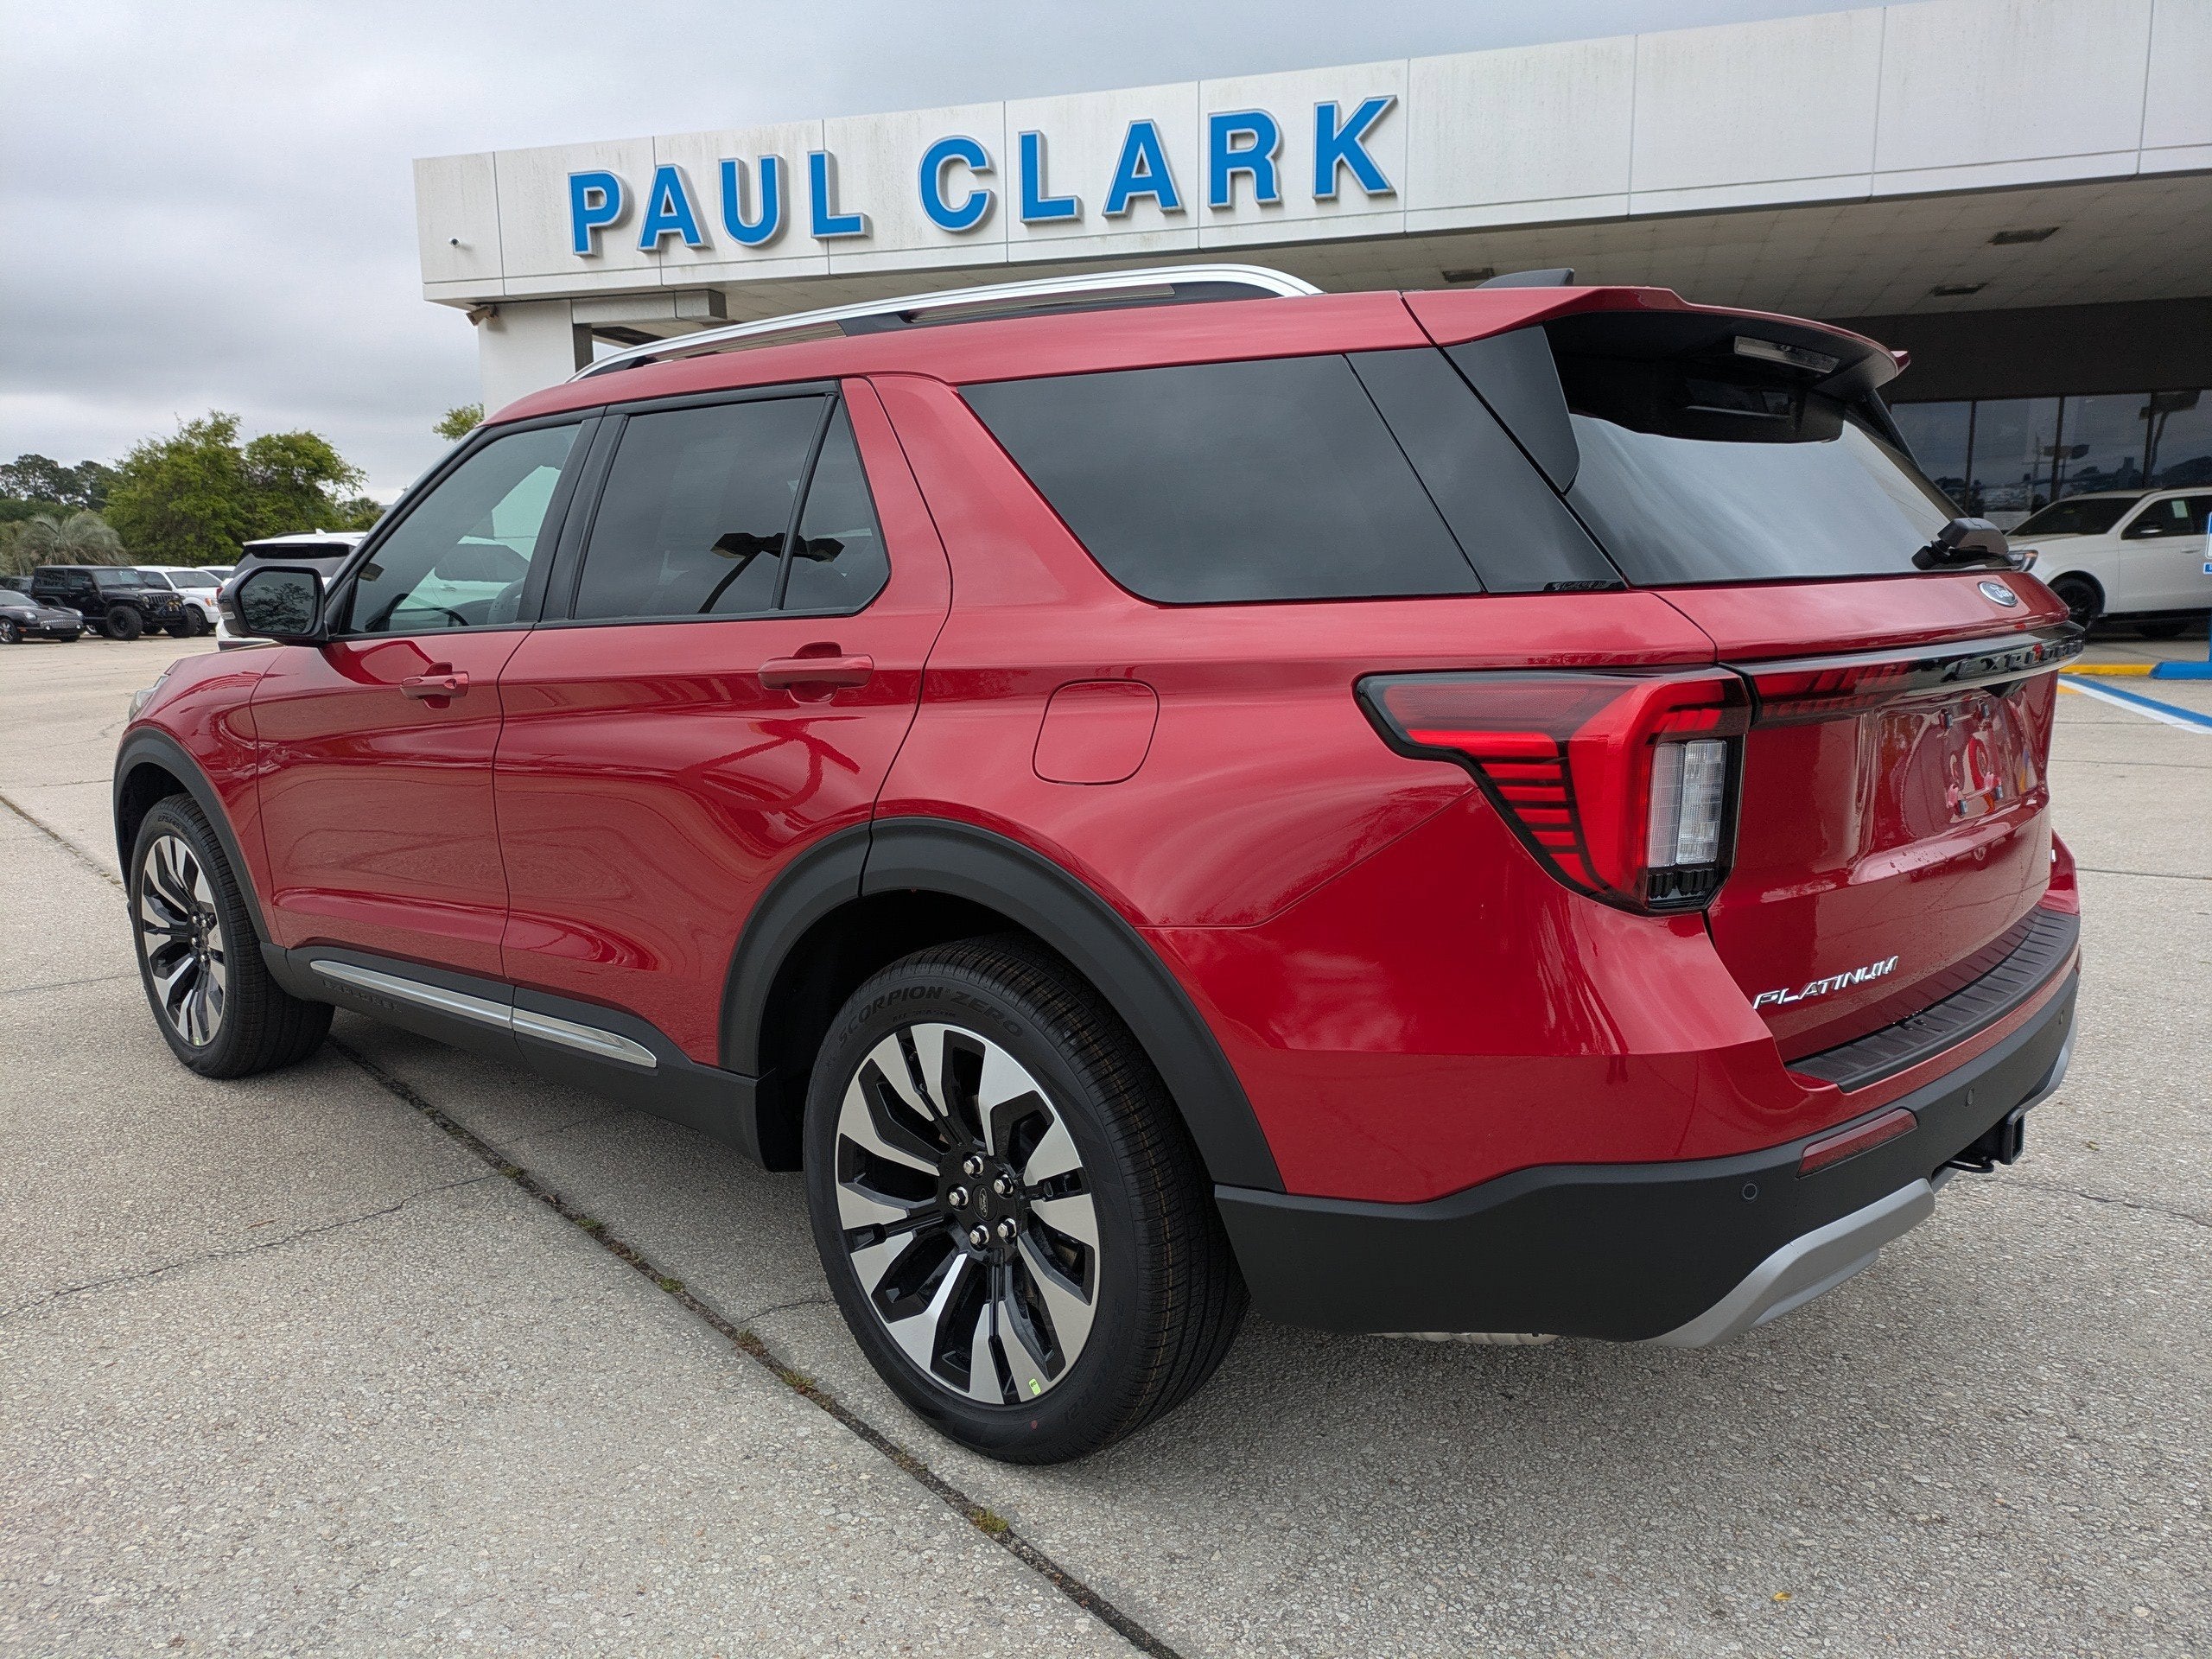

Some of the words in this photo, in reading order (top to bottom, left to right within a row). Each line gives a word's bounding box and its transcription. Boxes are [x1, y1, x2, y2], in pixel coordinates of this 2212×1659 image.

[567, 149, 867, 257] PAUL
[917, 95, 1399, 233] CLARK
[1752, 956, 1899, 1010] PLATINUM
[838, 985, 944, 1050] SCORPION
[950, 990, 1024, 1037] ZERO
